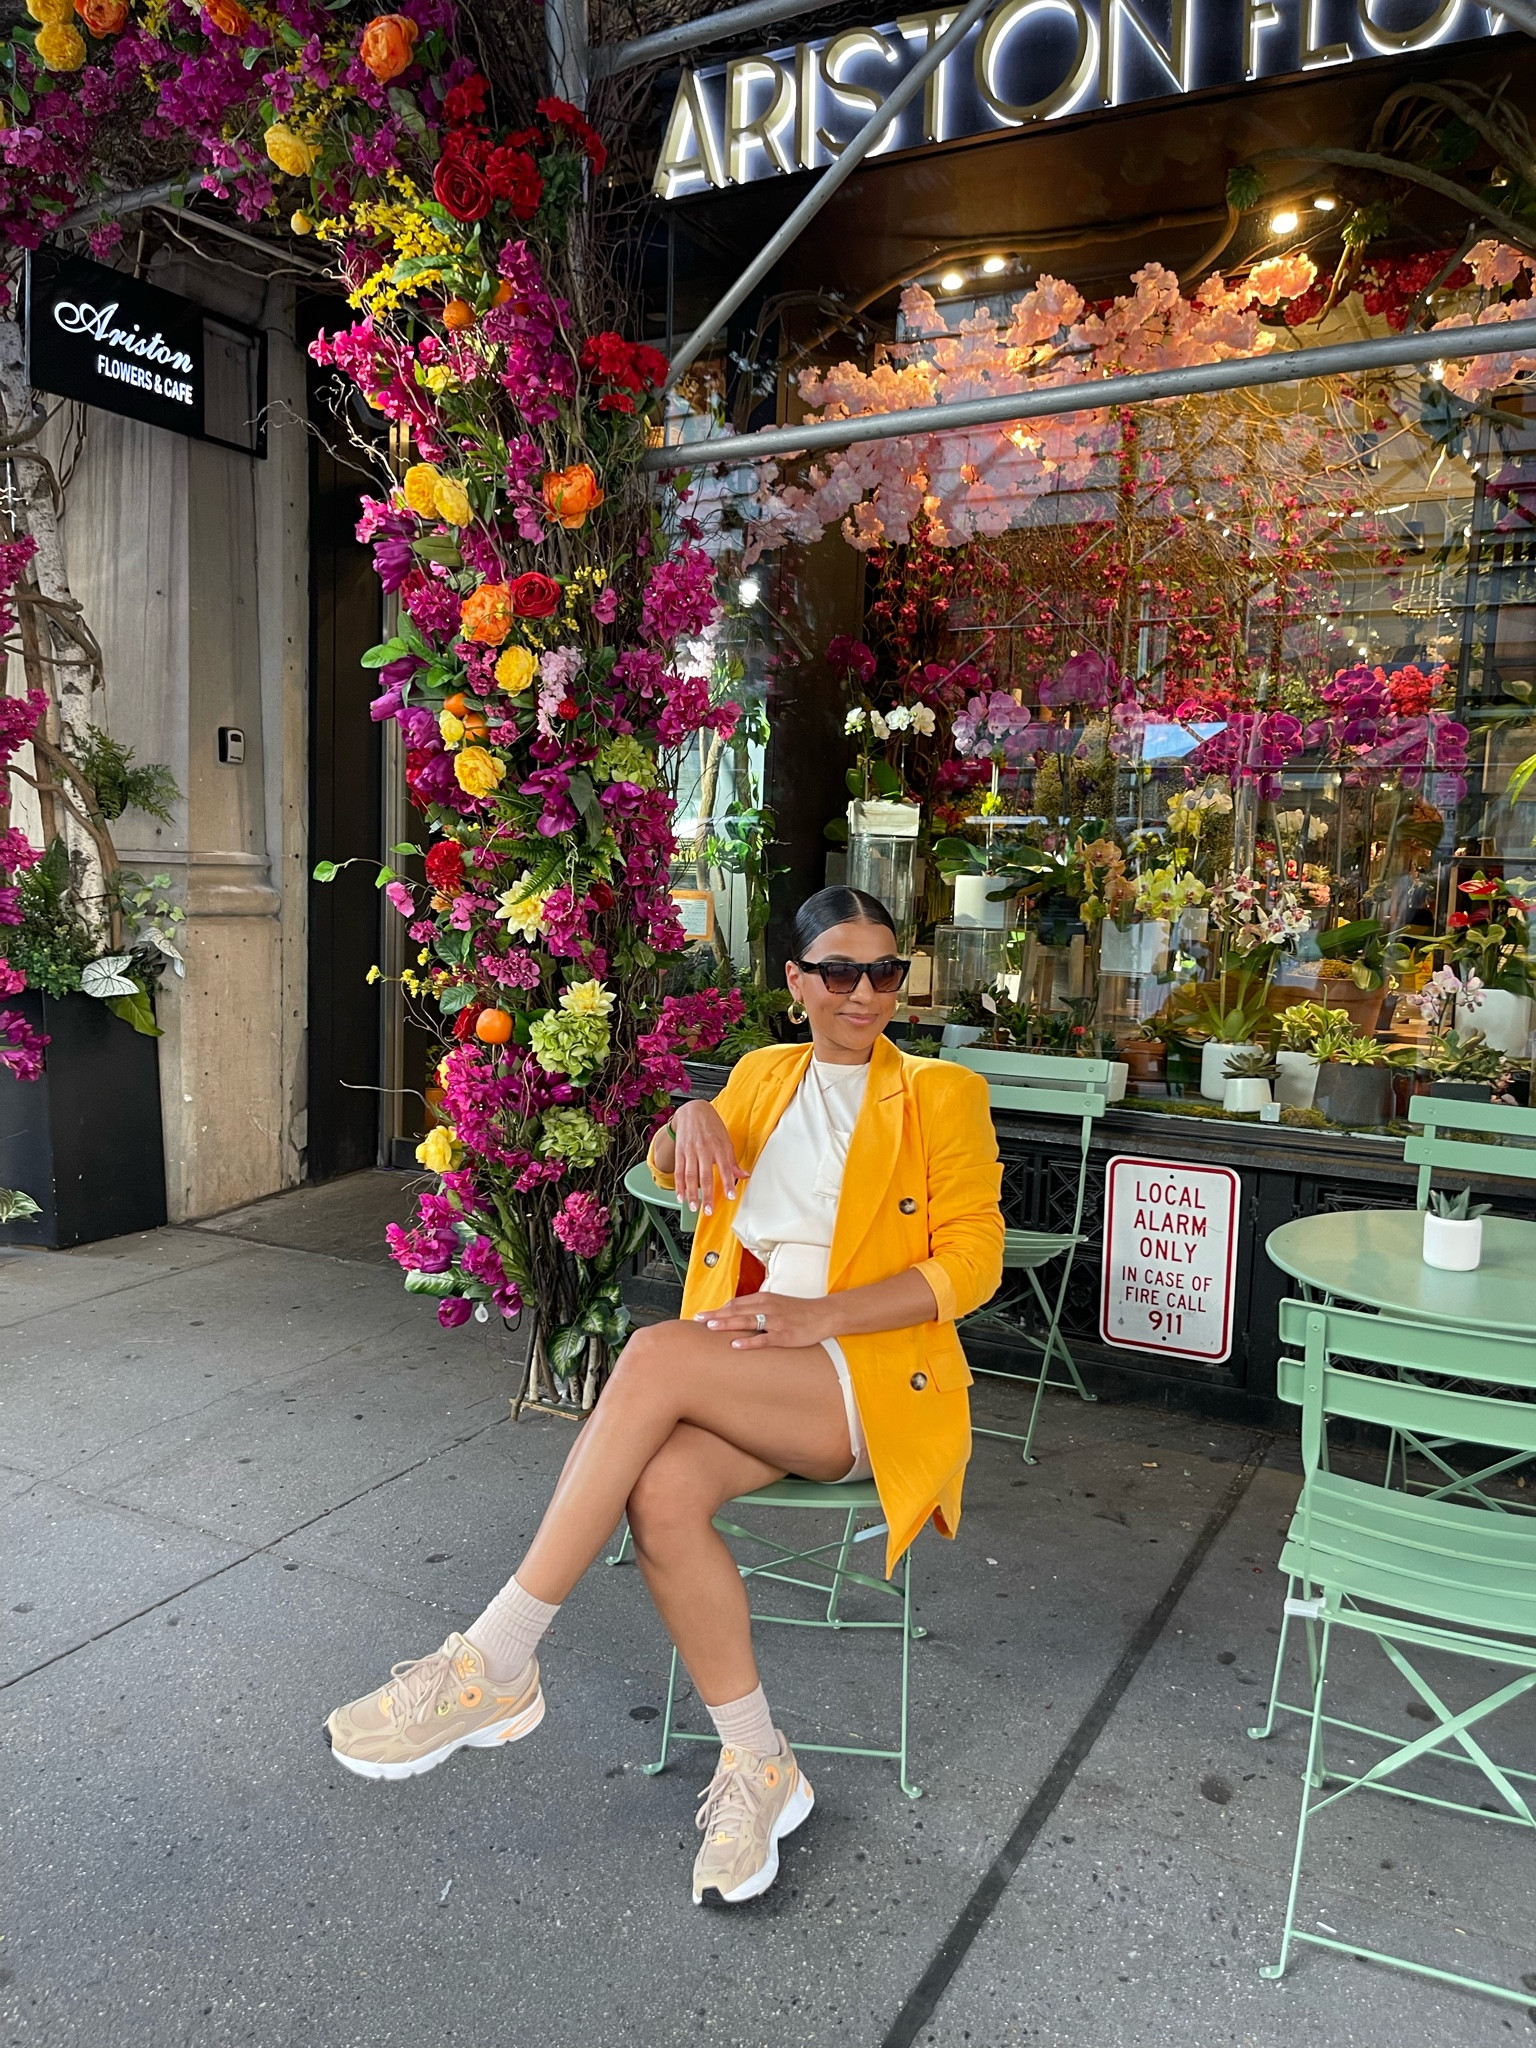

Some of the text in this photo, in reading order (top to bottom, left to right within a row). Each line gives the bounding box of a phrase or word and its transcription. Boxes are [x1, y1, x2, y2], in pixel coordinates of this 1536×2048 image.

[651, 0, 1504, 200] ARISTON FL
[54, 301, 193, 373] Ariston
[97, 354, 193, 405] FLOWERS & CAFE
[1136, 1181, 1206, 1210] LOCAL
[1133, 1210, 1207, 1237] ALARM
[1140, 1238, 1197, 1263] ONLY
[1122, 1265, 1213, 1293] IN CASE OF
[1125, 1286, 1207, 1313] FIRE CALL
[1149, 1311, 1182, 1334] 911
